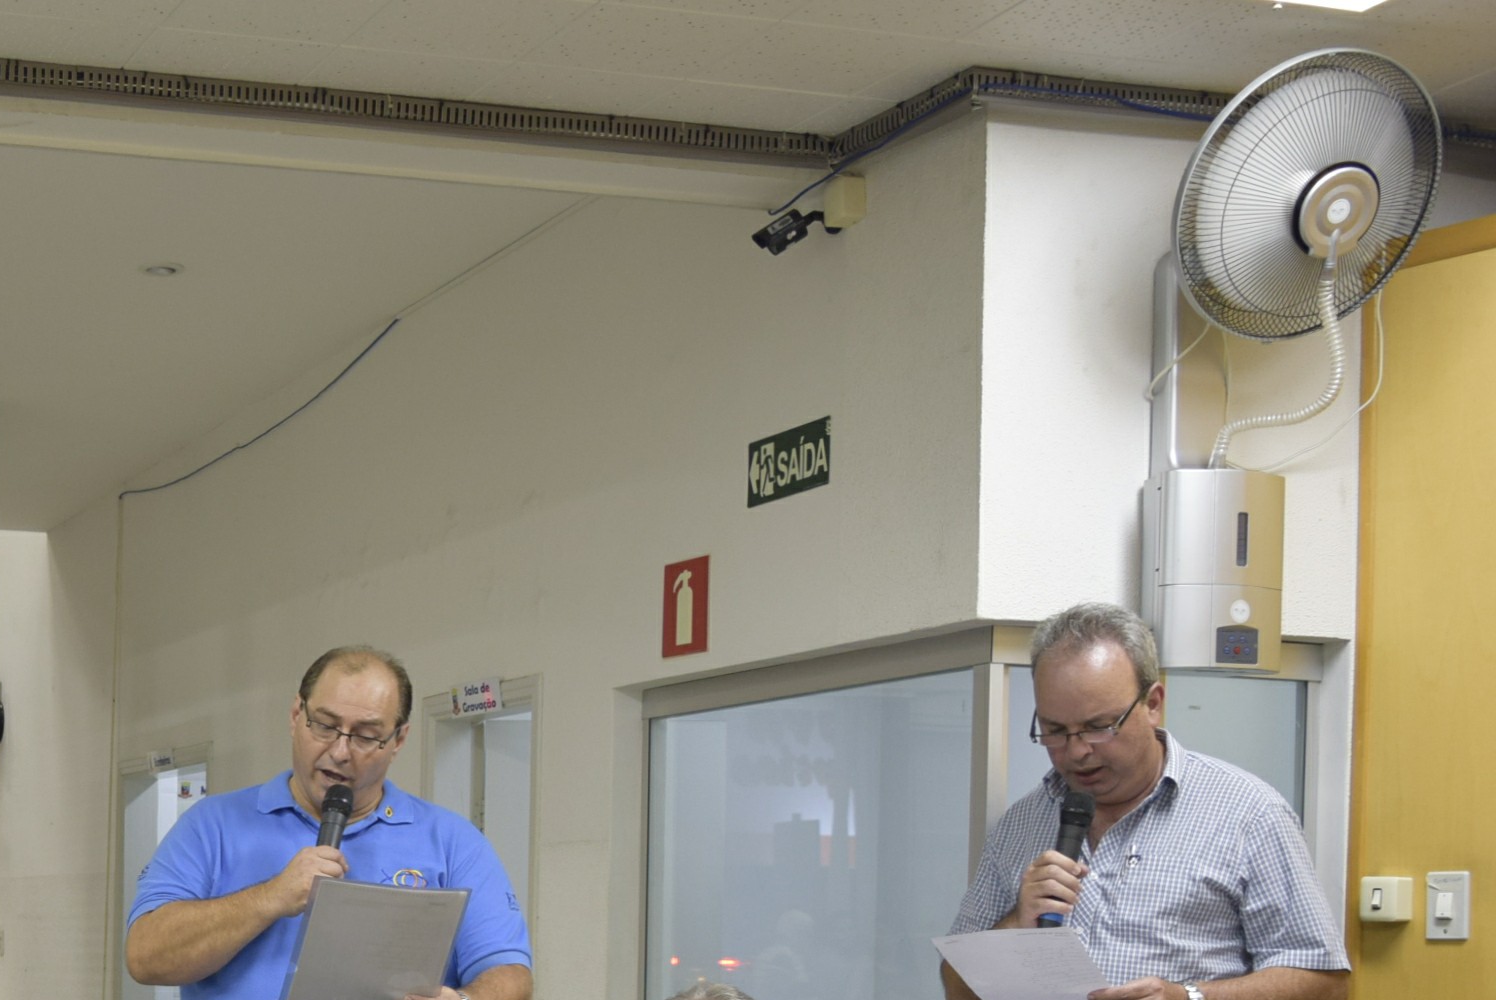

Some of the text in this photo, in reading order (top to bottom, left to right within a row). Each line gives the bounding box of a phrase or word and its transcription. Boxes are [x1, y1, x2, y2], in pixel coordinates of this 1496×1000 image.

[776, 436, 828, 486] SAÍDA
[464, 682, 490, 697] Sala de
[462, 698, 496, 713] Gravação
